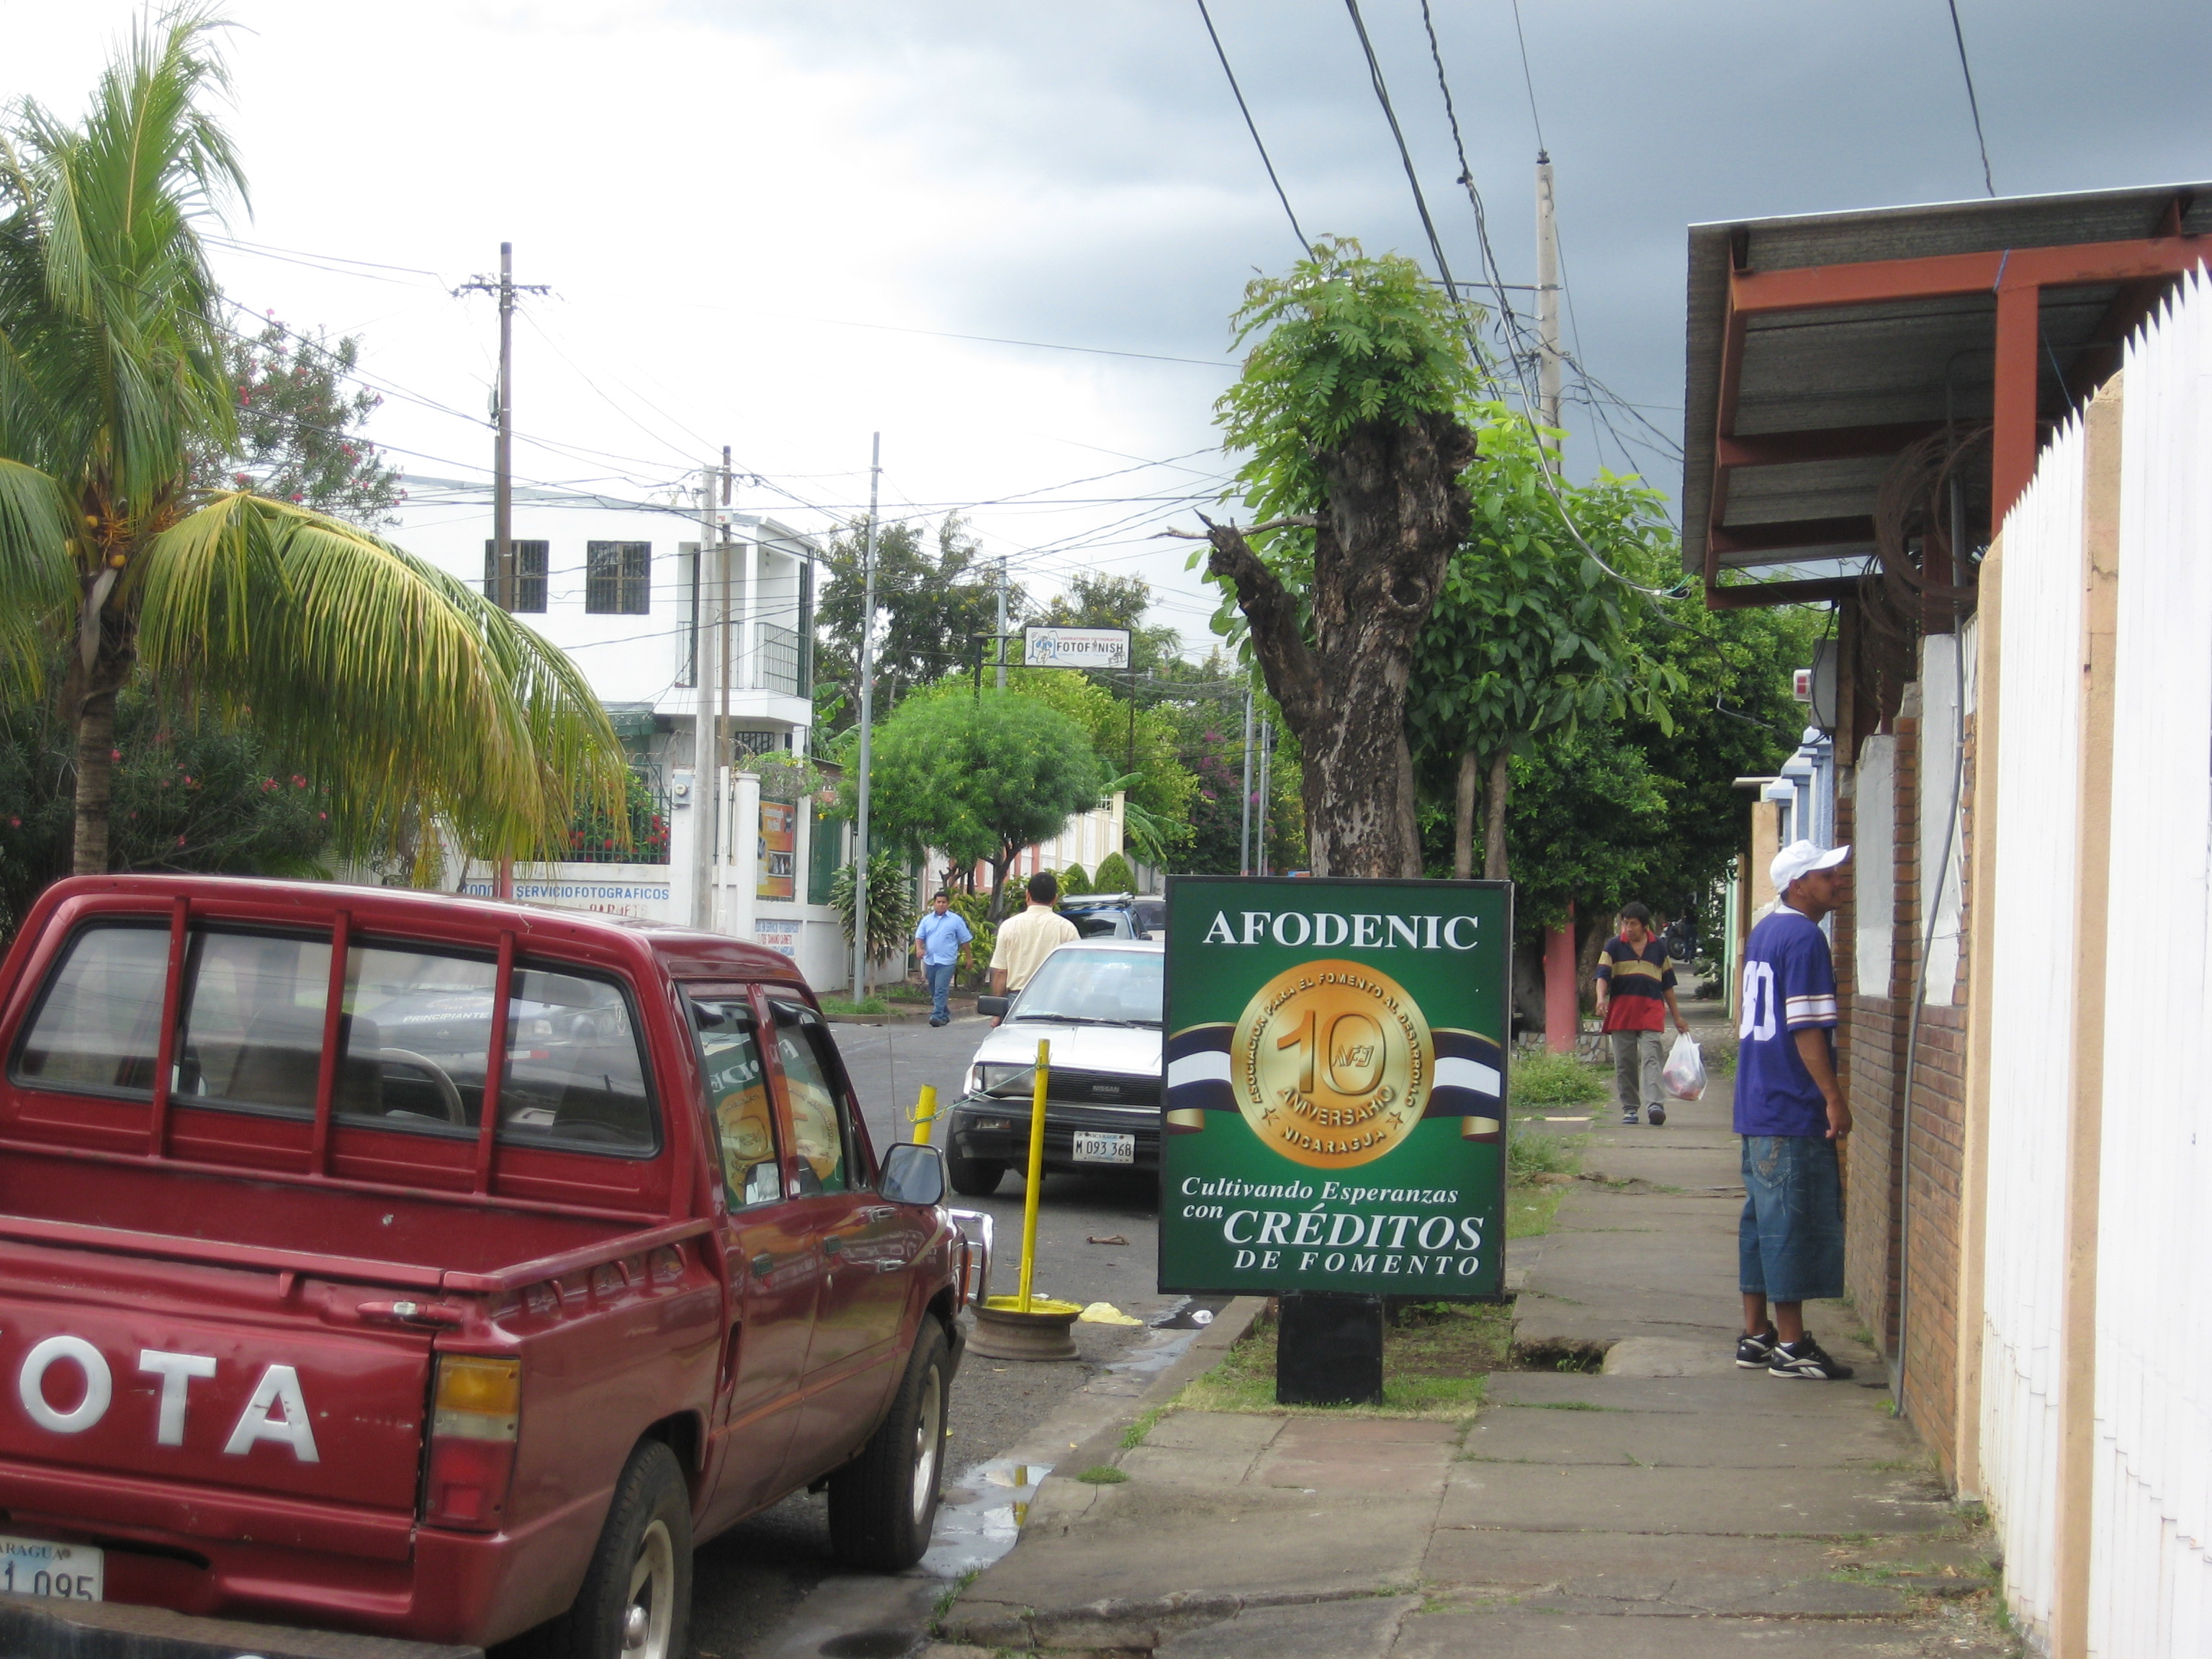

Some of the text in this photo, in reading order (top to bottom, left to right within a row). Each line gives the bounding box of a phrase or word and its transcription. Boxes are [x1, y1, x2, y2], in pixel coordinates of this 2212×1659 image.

[516, 885, 573, 899] SERVICIO
[575, 886, 669, 900] FOTOGRAFICOS
[1202, 909, 1479, 950] AFODENIC
[403, 1012, 490, 1022] PRINCIPIANTE
[1246, 973, 1421, 1107] ASOCIACION PARA EL FOMENTO AL DESARROLLO
[1277, 1010, 1387, 1096] 10
[1277, 1086, 1395, 1127] ANIVERSARIO
[1087, 1141, 1107, 1155] 093
[1111, 1142, 1132, 1156] 368
[1282, 1126, 1387, 1154] NICARAGUA
[1182, 1177, 1460, 1205] Cultivando Esperanzas
[1183, 1202, 1484, 1251] con CRÉDITOS
[1234, 1249, 1481, 1277] DE FOMENTO
[34, 1570, 94, 1602] 095
